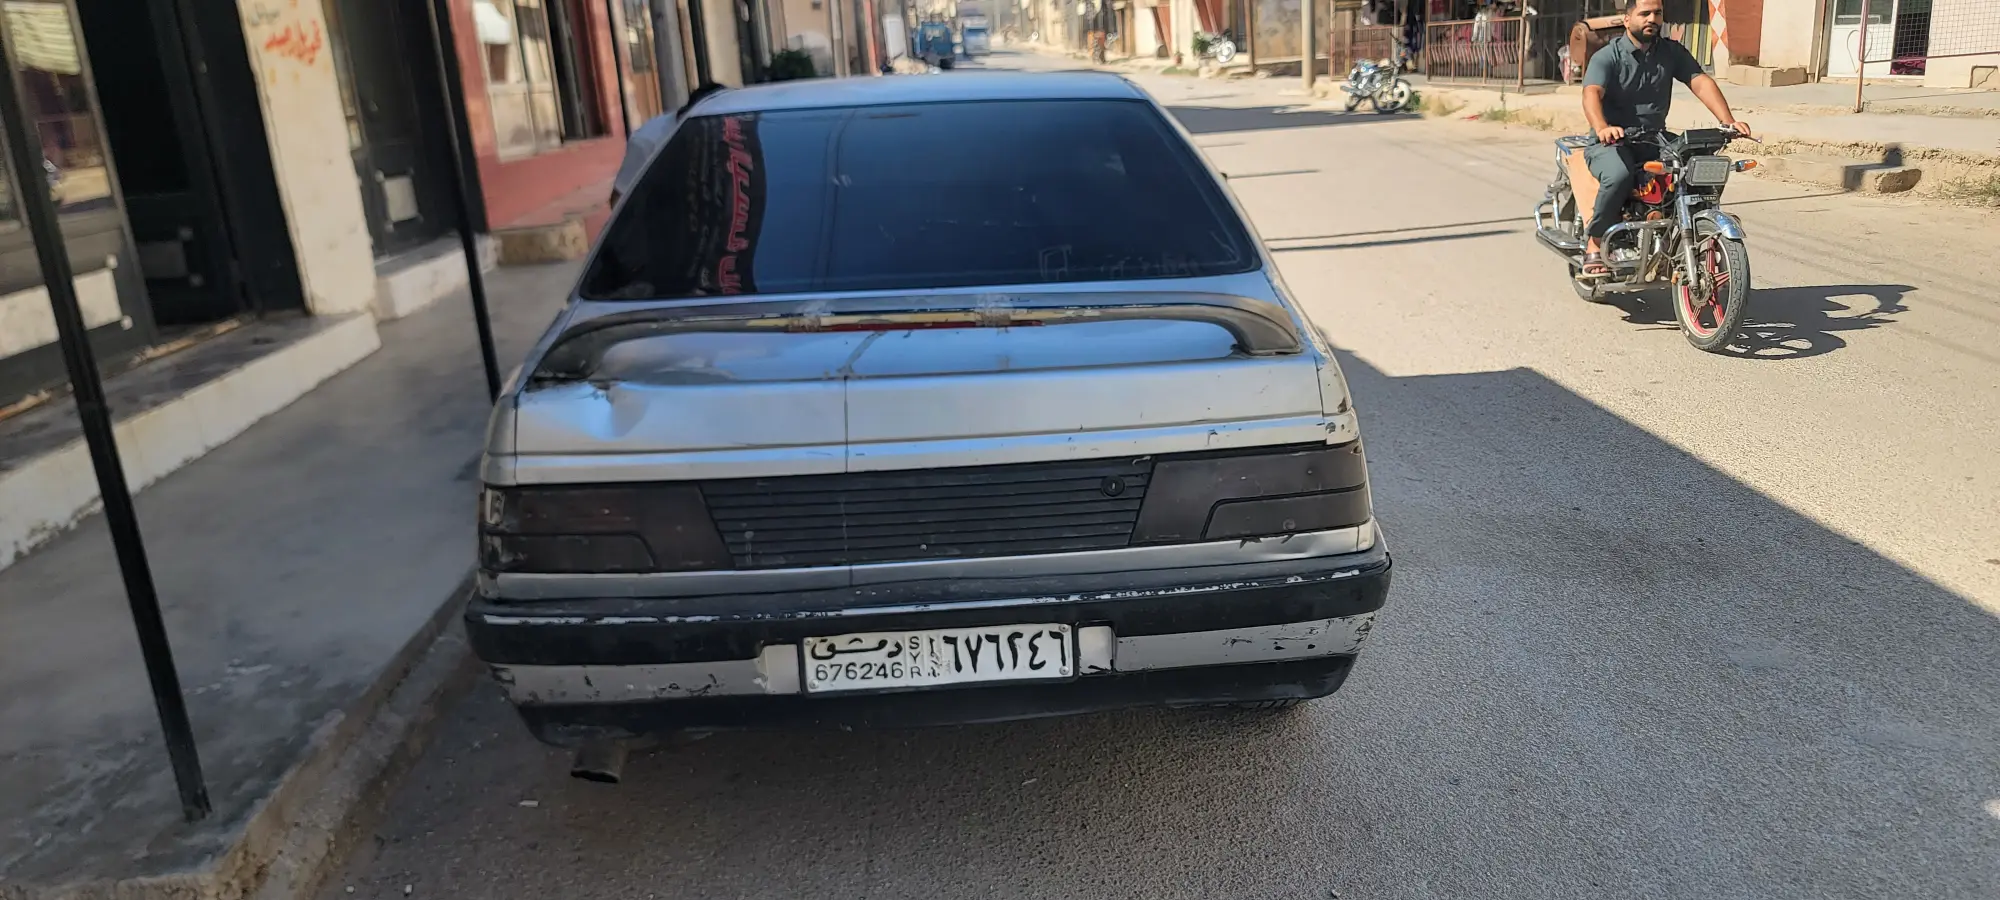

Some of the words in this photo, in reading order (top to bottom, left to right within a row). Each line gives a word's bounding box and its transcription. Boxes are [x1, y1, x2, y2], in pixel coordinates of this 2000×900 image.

[810, 637, 903, 660] دمشق
[909, 635, 922, 679] SYR
[942, 629, 1067, 675] ٦٧٦٢٤٦
[814, 661, 904, 682] 676246
